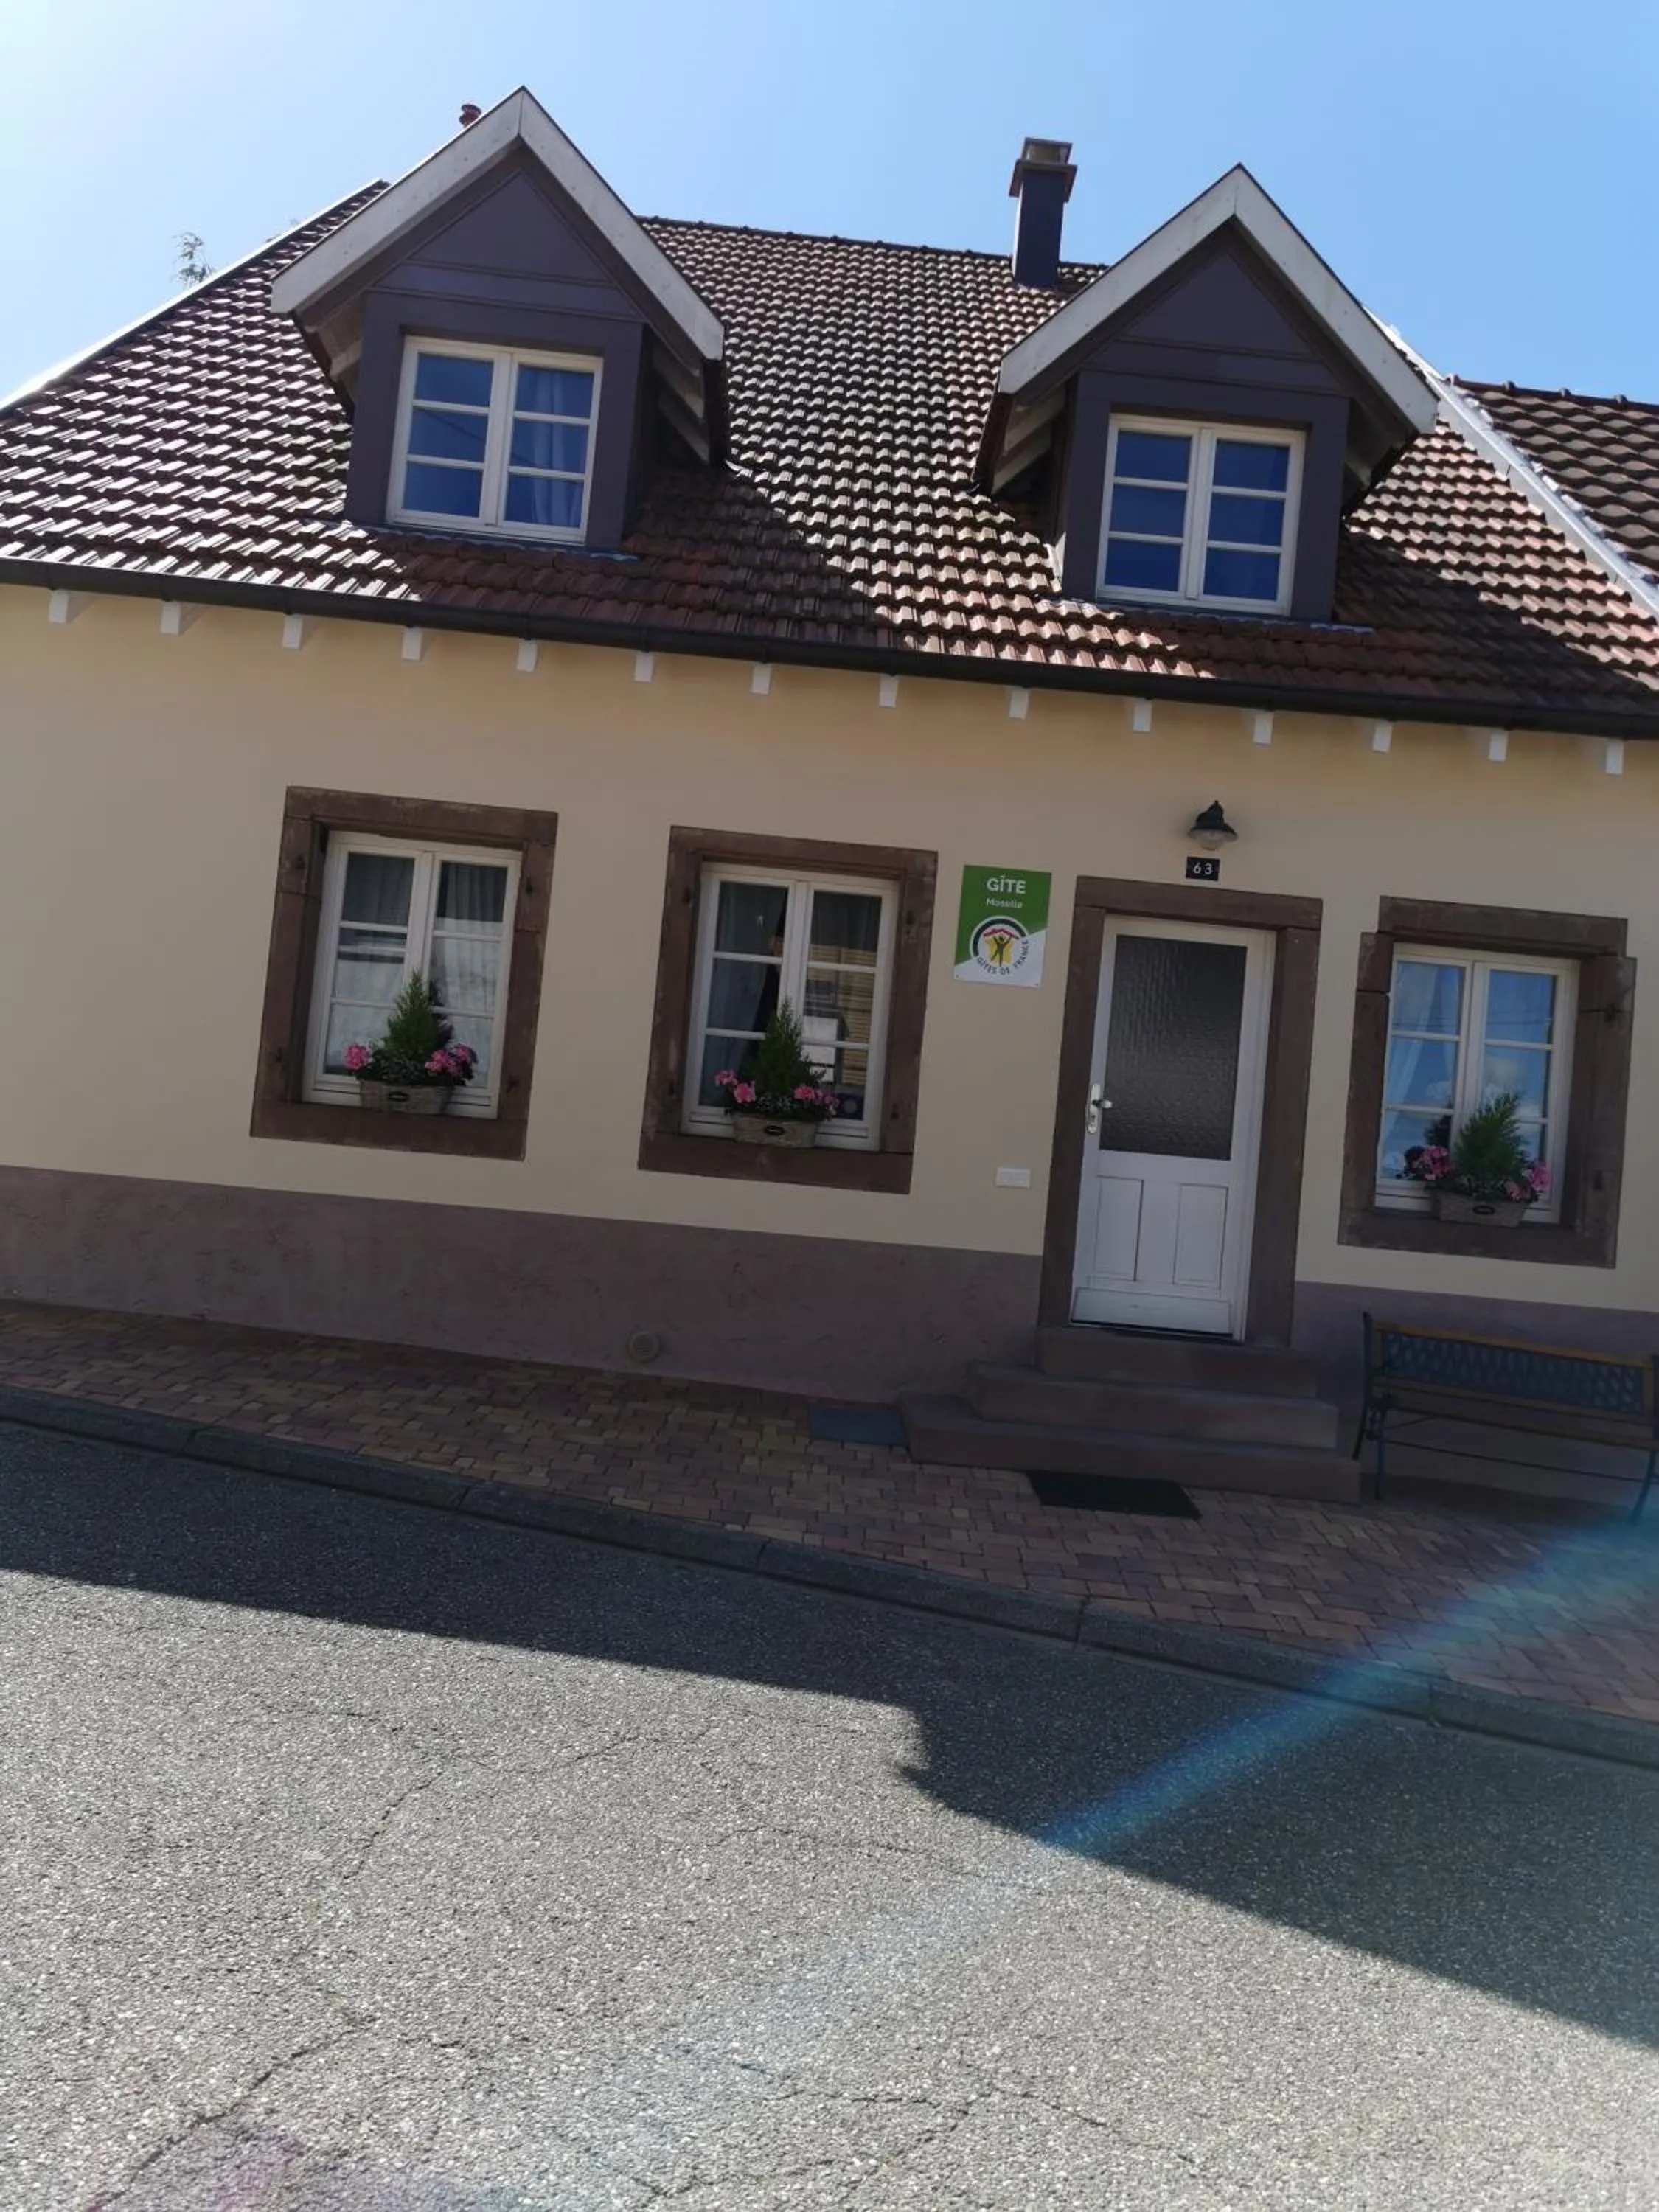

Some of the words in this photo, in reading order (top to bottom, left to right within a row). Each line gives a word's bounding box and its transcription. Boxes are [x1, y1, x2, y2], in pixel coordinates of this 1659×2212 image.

[1193, 862, 1212, 875] 63
[986, 897, 1023, 909] Moselle
[1013, 939, 1030, 970] FRANCE
